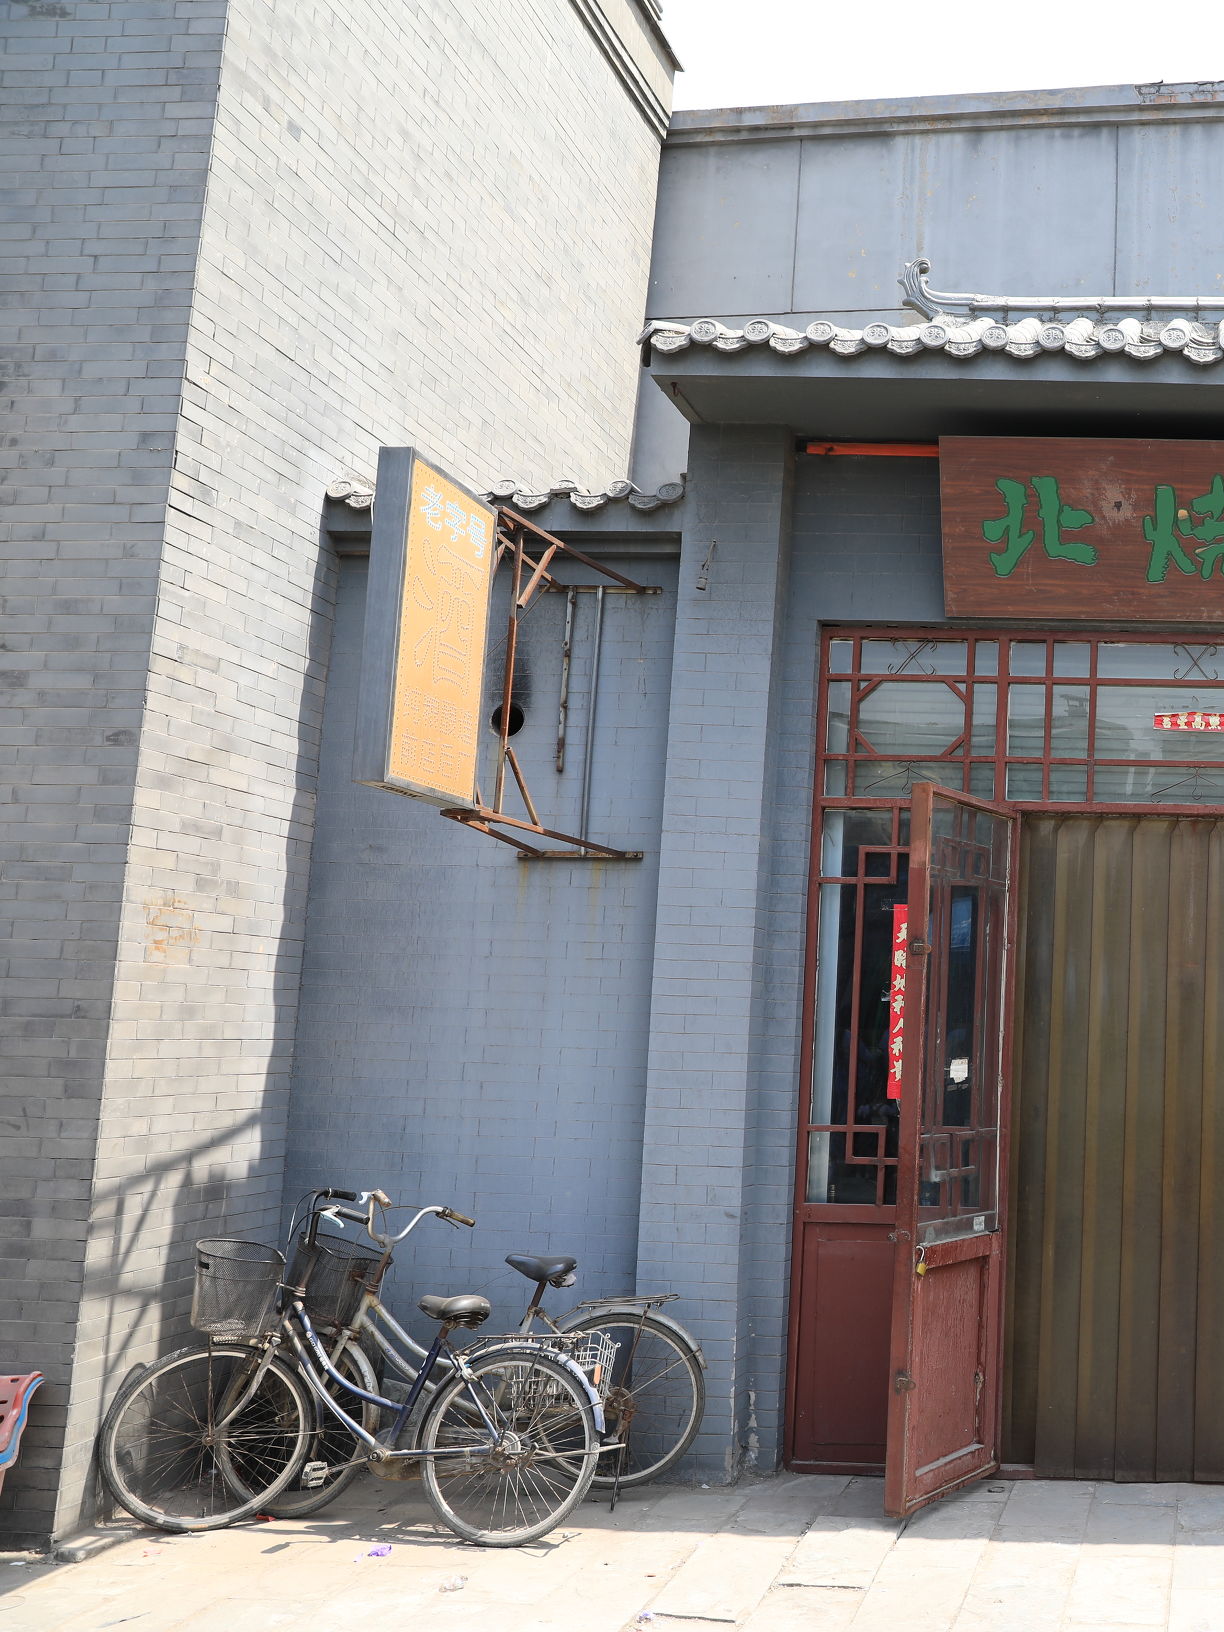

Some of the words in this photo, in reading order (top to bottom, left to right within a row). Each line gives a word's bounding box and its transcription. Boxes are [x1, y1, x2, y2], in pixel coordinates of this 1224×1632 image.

[420, 484, 488, 558] 老字号
[412, 536, 485, 696] 酒
[401, 728, 472, 780] 前店后厂
